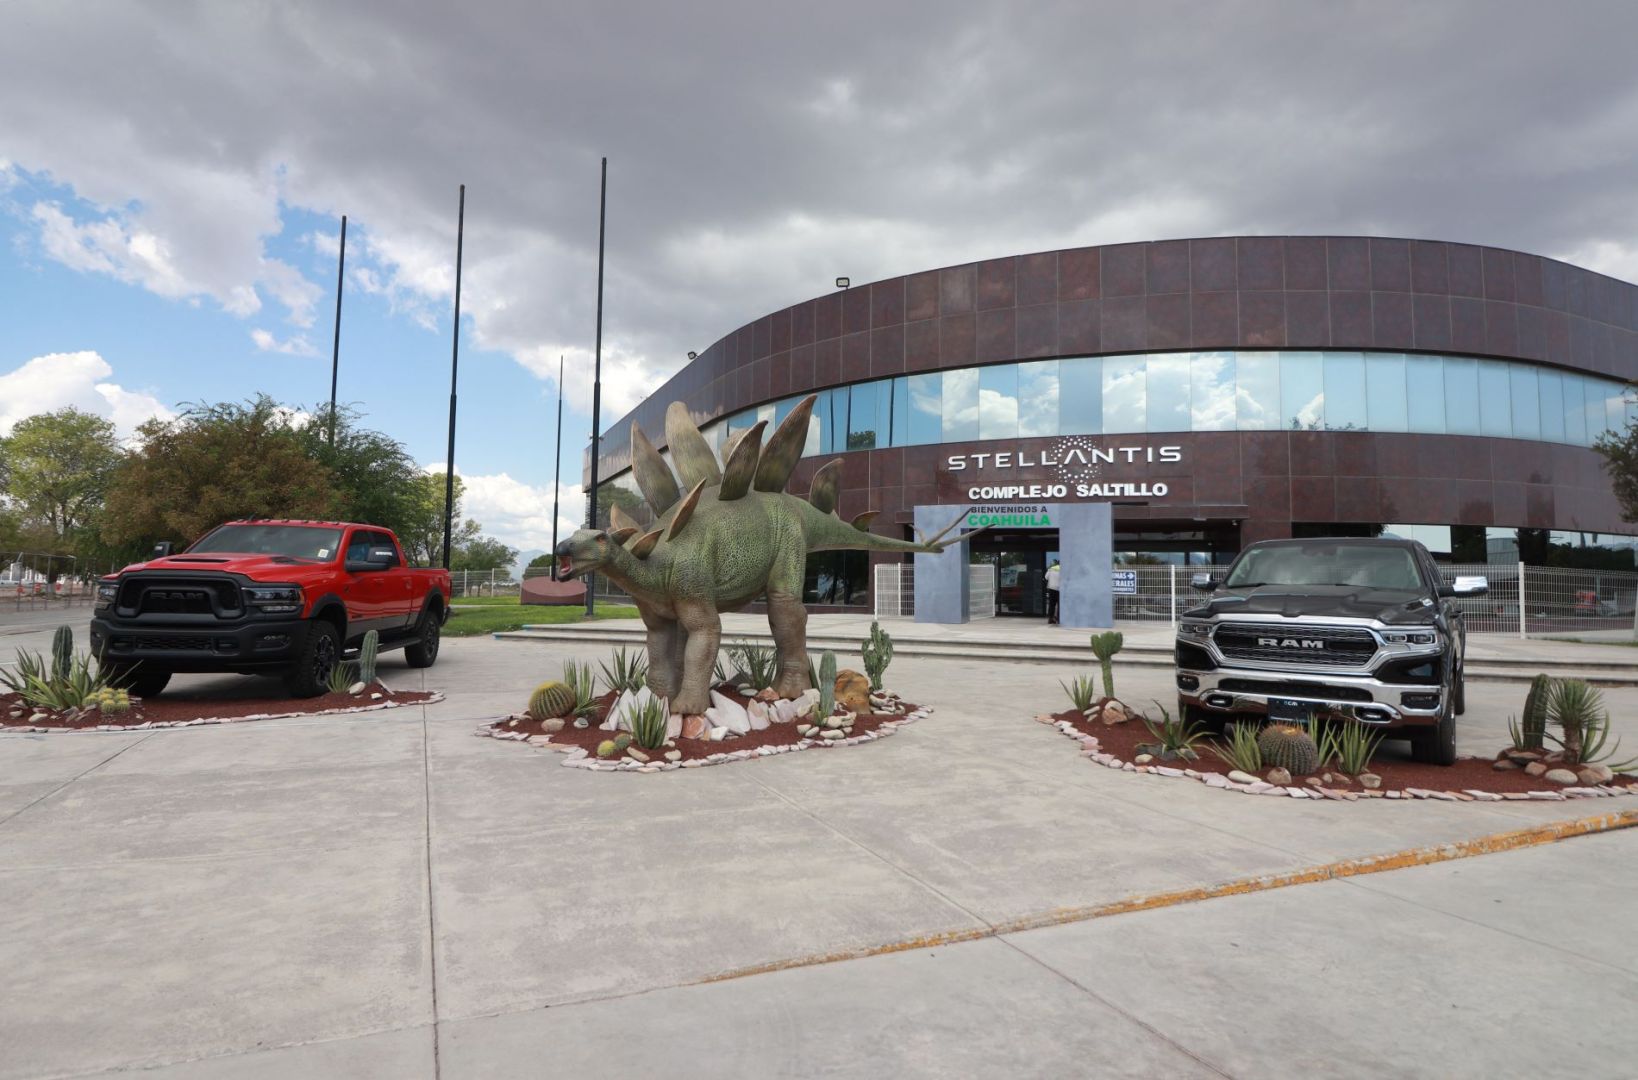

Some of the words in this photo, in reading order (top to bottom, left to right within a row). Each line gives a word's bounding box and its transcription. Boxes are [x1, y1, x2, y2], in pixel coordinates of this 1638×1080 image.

[948, 446, 1182, 471] STELLANTIS
[968, 485, 1067, 500] COMPLEJO
[1076, 483, 1168, 498] SALTILLO
[967, 514, 1051, 526] COAHUILA
[1258, 638, 1324, 649] RAM
